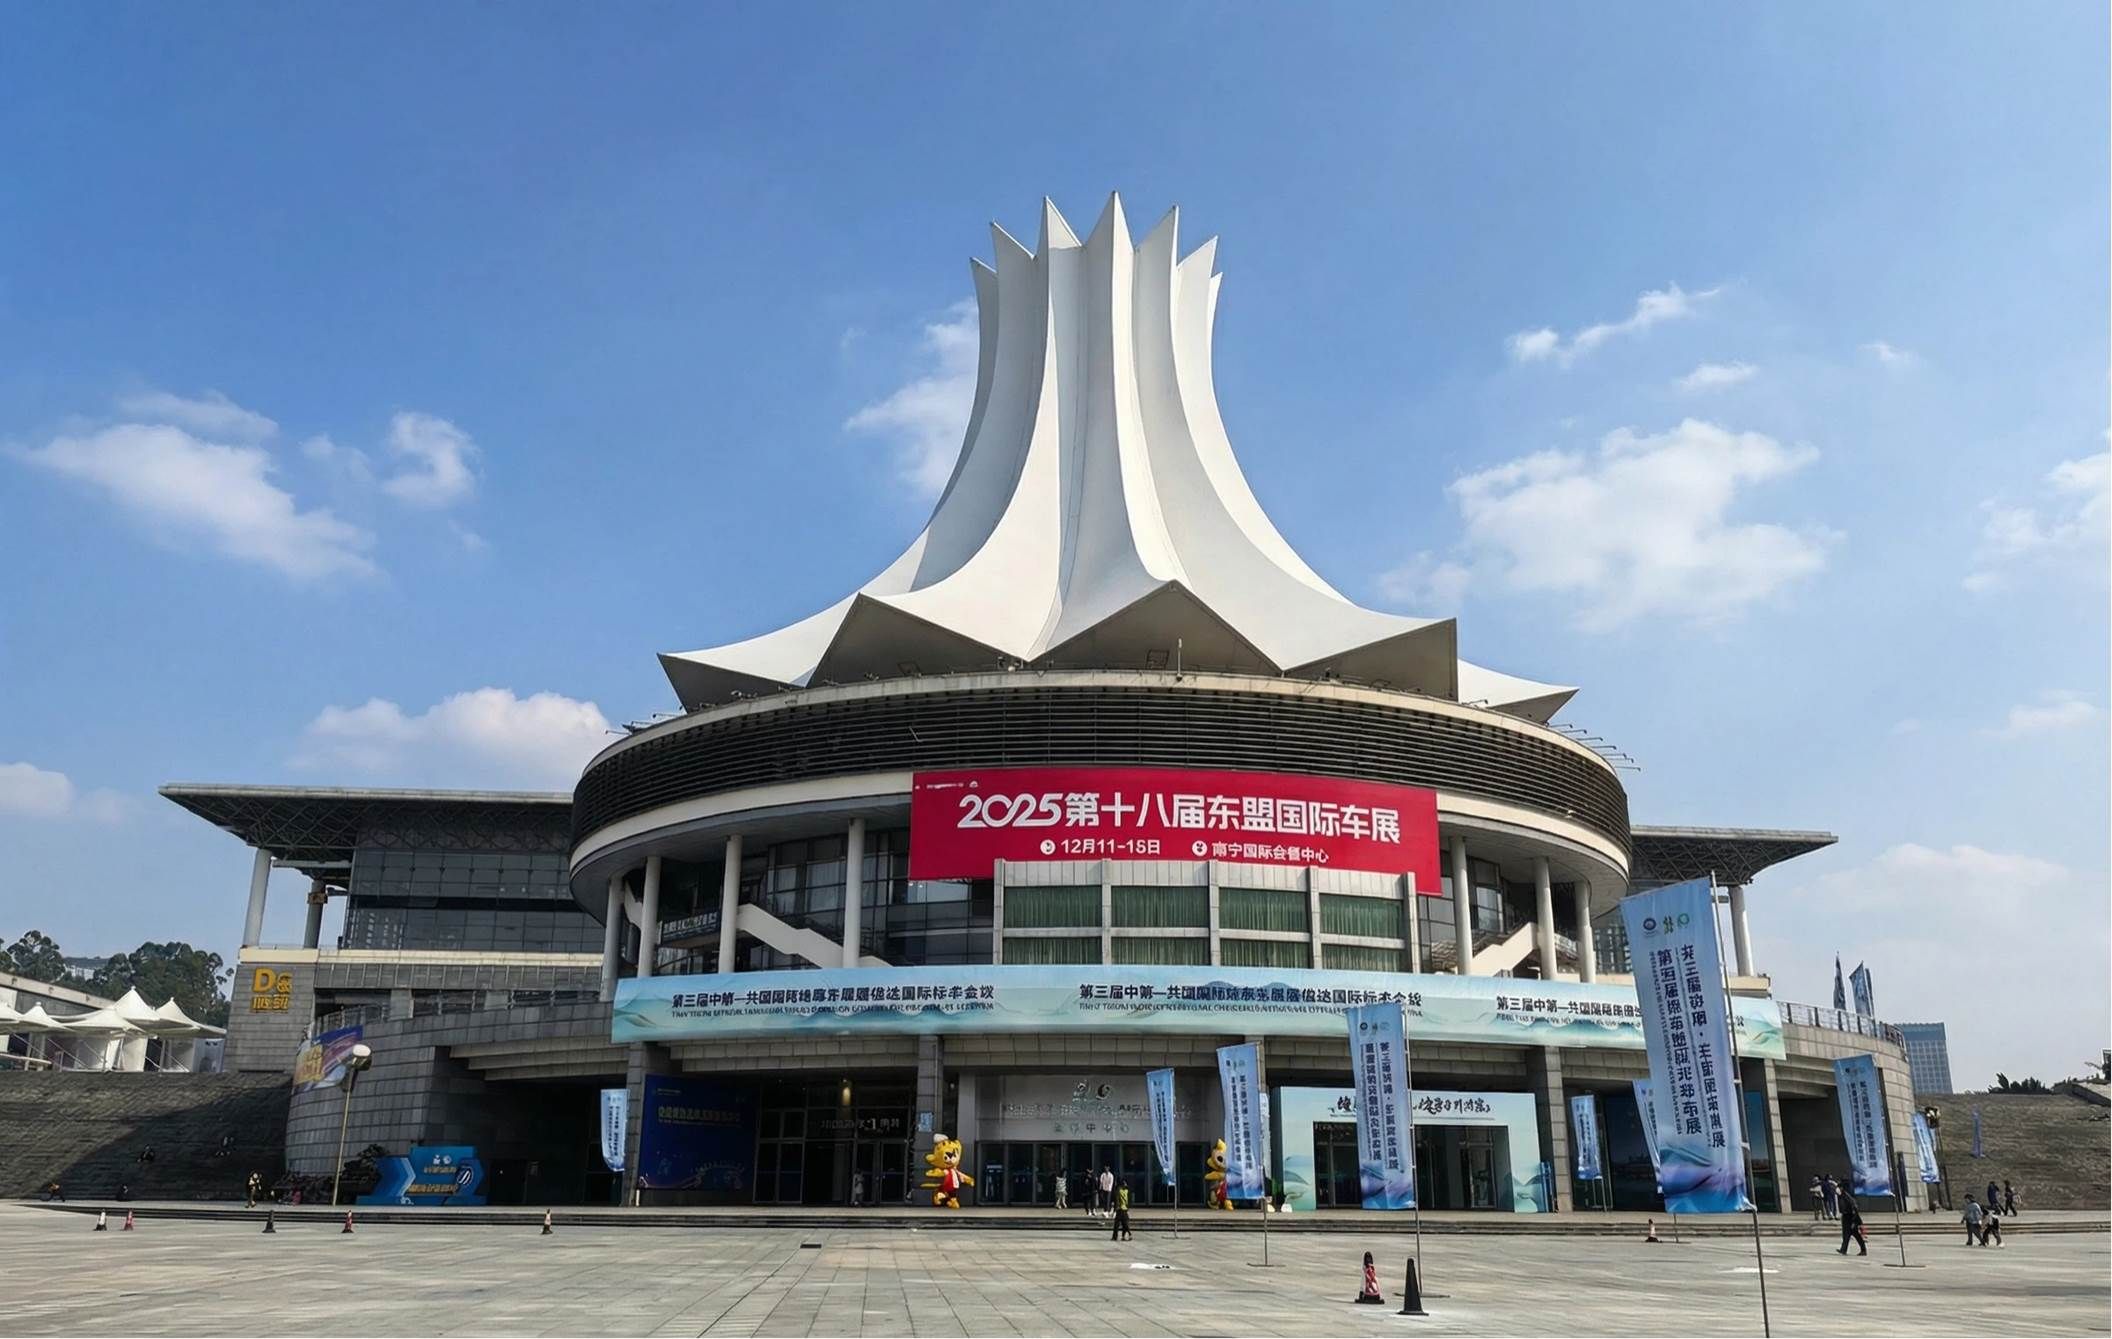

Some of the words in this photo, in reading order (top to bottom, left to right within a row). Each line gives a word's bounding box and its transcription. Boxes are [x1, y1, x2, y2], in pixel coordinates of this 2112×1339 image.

[957, 792, 1400, 843] 2025第十八届东盟国际车展
[1061, 839, 1160, 854] 12月11-15日
